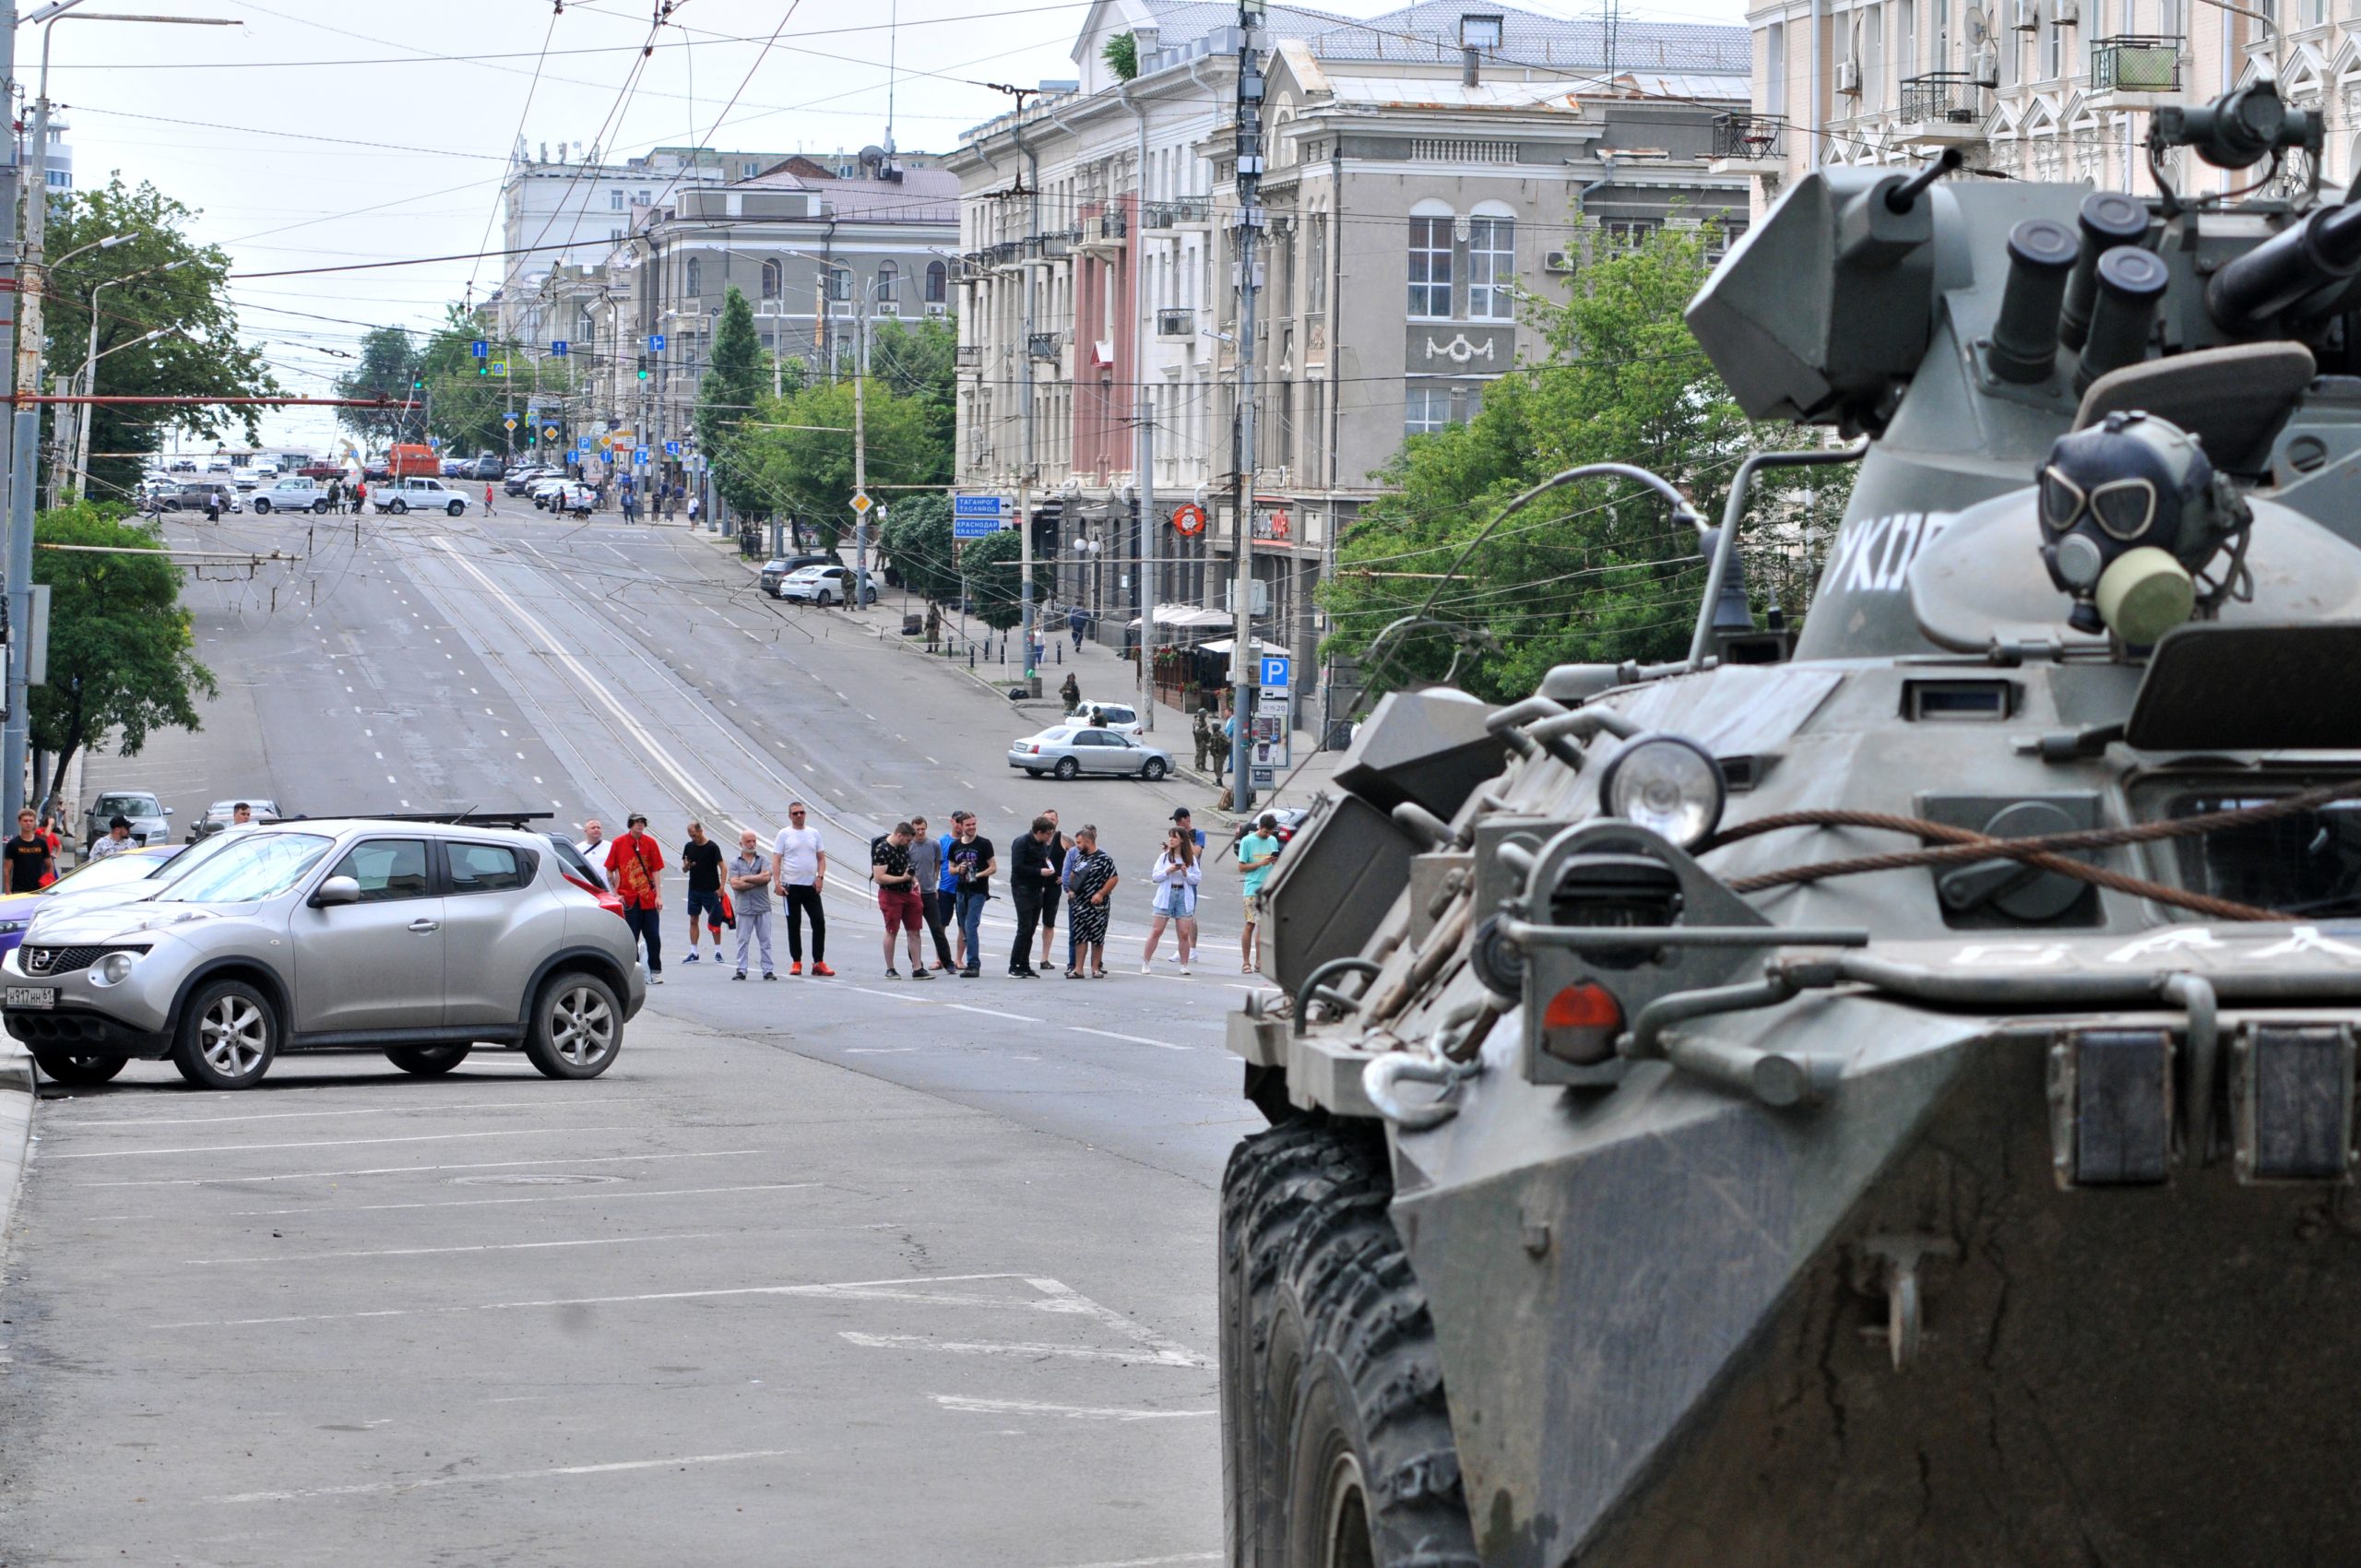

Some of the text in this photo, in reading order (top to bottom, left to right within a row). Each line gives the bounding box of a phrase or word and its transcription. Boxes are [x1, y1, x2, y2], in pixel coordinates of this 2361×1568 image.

[581, 438, 588, 447] P
[1267, 661, 1284, 683] P
[43, 988, 52, 1000] 61
